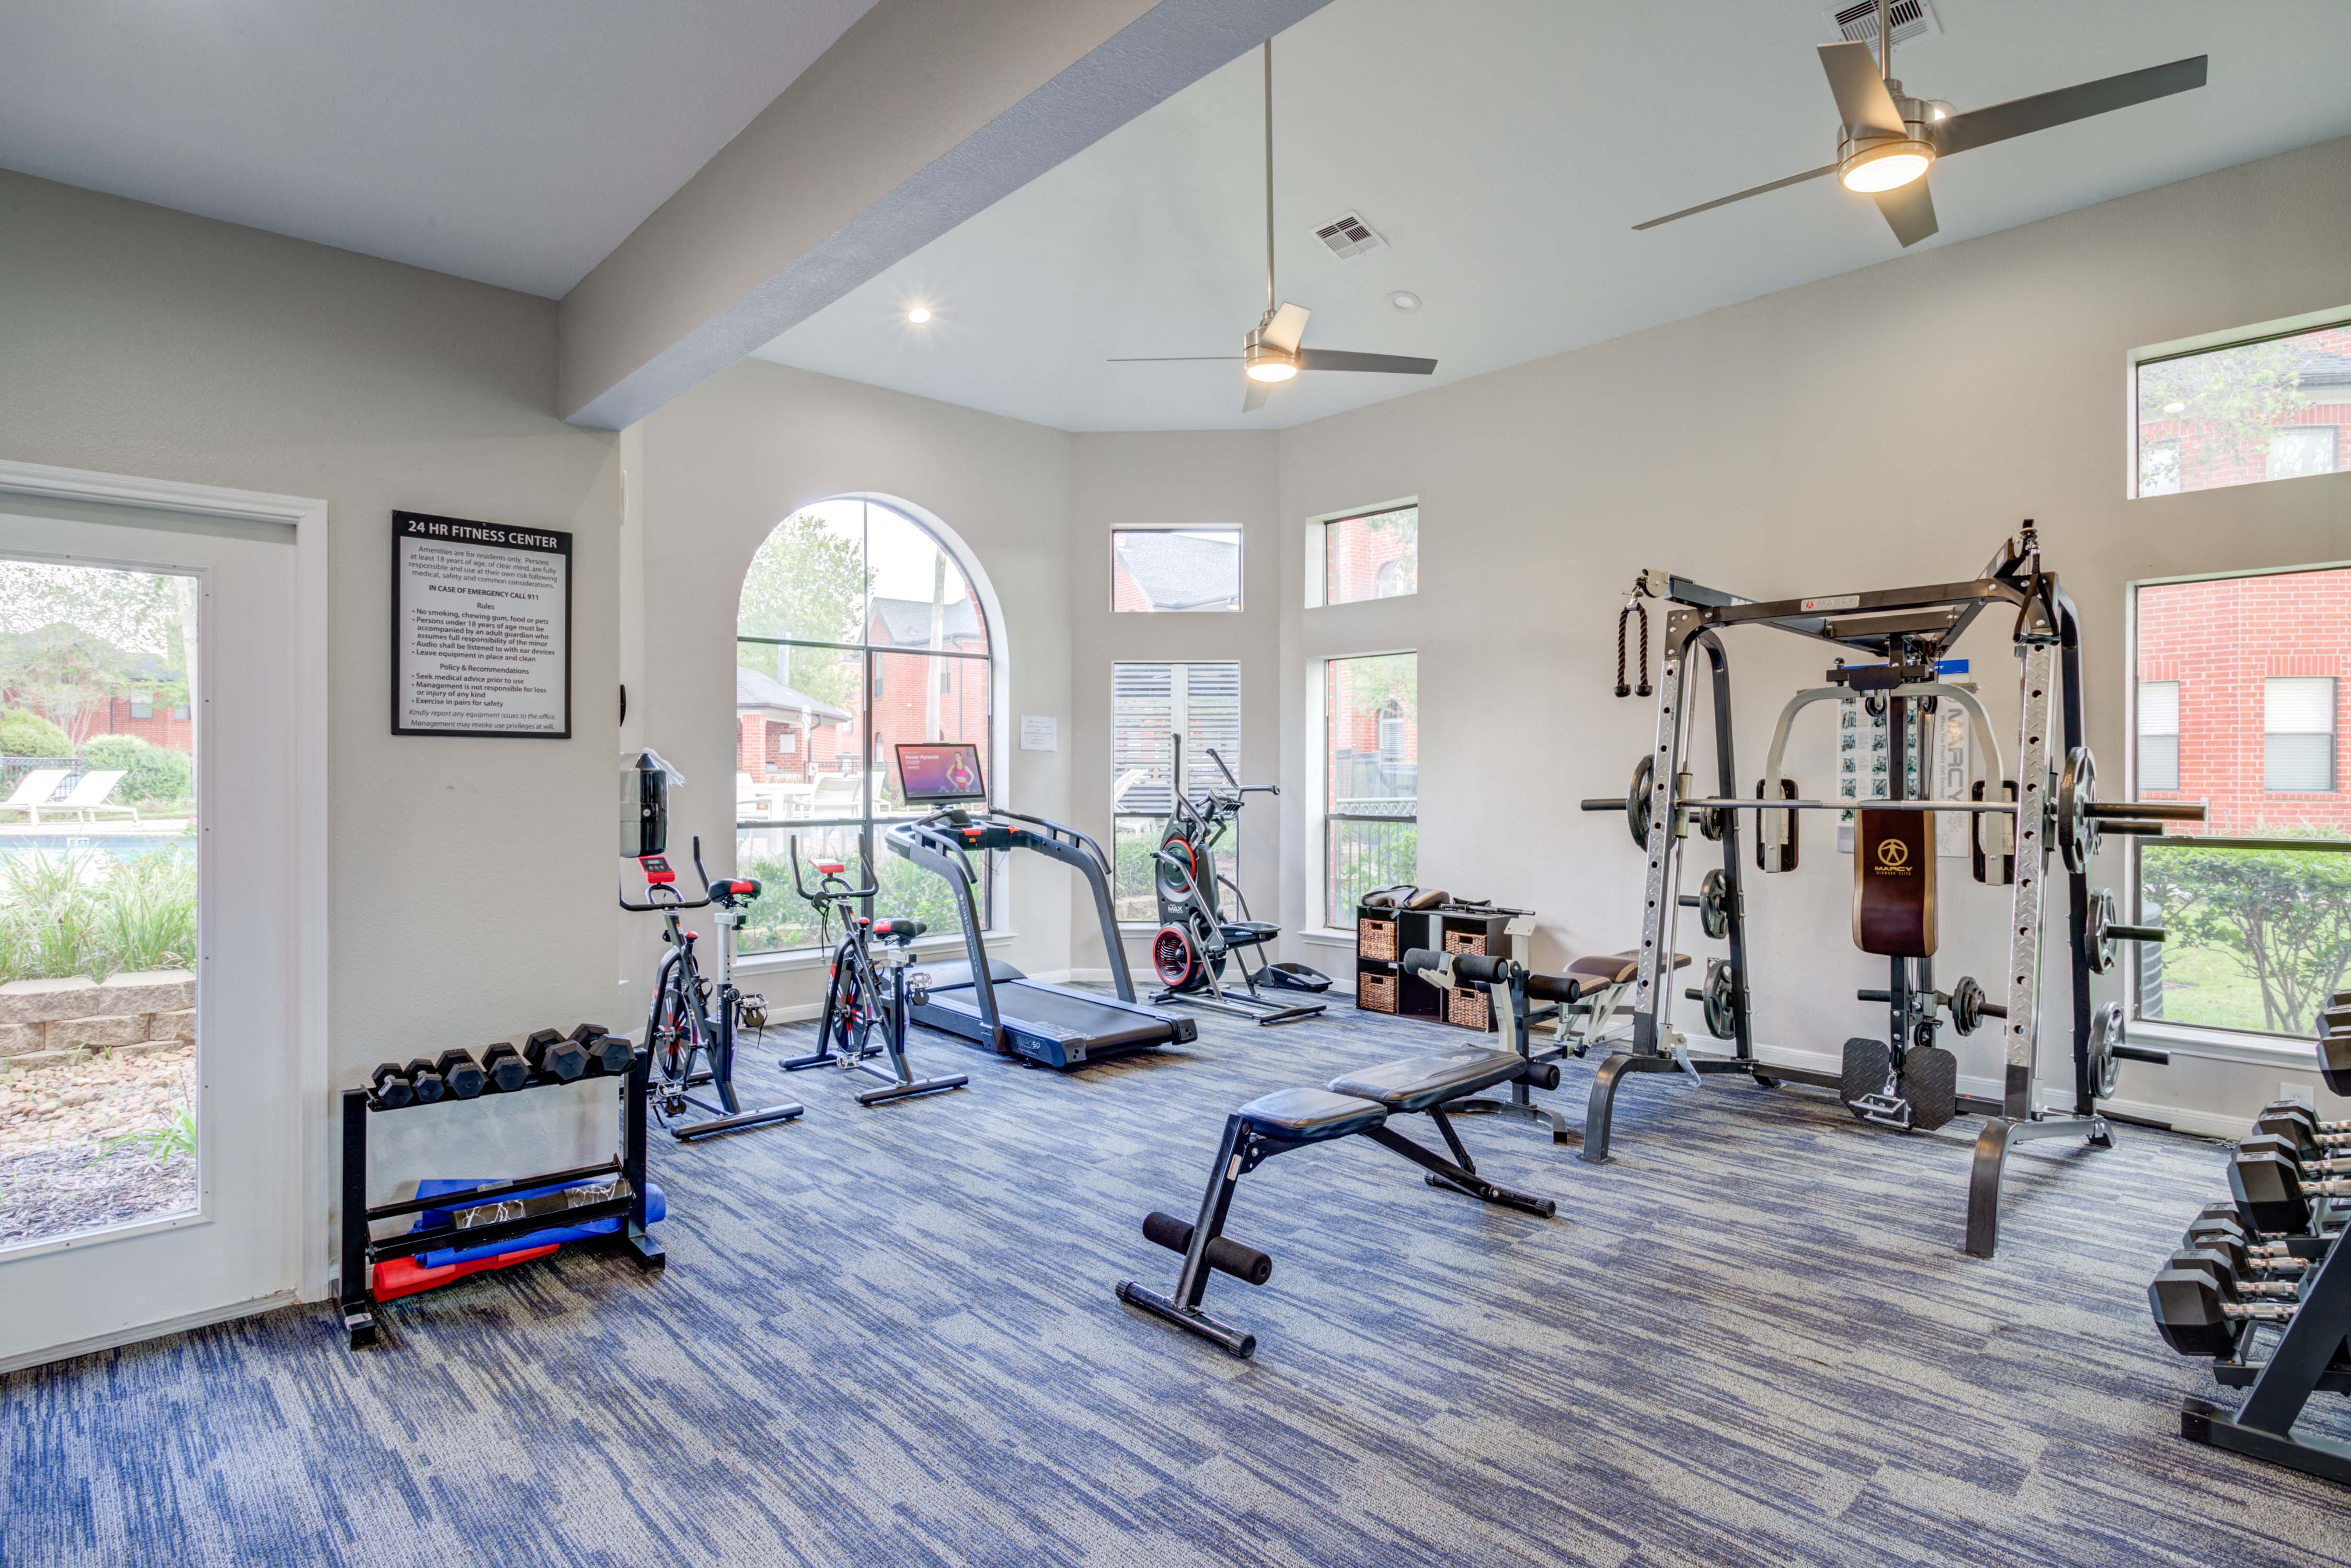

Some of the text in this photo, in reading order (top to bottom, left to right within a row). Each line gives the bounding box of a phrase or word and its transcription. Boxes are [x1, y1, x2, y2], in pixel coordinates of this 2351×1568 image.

[408, 520, 557, 548] 24 HR FITNESS CENTER
[418, 545, 453, 555] Amenities
[476, 552, 506, 561] residents
[525, 557, 549, 566] Persons
[408, 560, 448, 572] responsible
[529, 573, 557, 583] following
[542, 567, 556, 575] fully
[442, 572, 462, 581] safety
[467, 588, 509, 597] EMERGENCY
[1817, 597, 1855, 607] MARCY
[416, 616, 443, 625] Persons
[461, 612, 490, 621] chewing
[417, 624, 464, 635] accompanied
[504, 630, 533, 640] guardian
[461, 635, 507, 645] responsibility
[438, 650, 476, 660] equipment
[485, 653, 503, 661] place
[439, 663, 460, 672] Policy
[468, 665, 529, 674] Recommendations
[416, 681, 462, 690] Management
[484, 684, 522, 693] responsible
[426, 689, 446, 698] injury
[411, 720, 455, 728] Management
[1948, 708, 1964, 802] MARCY
[960, 901, 971, 937] ECHELON
